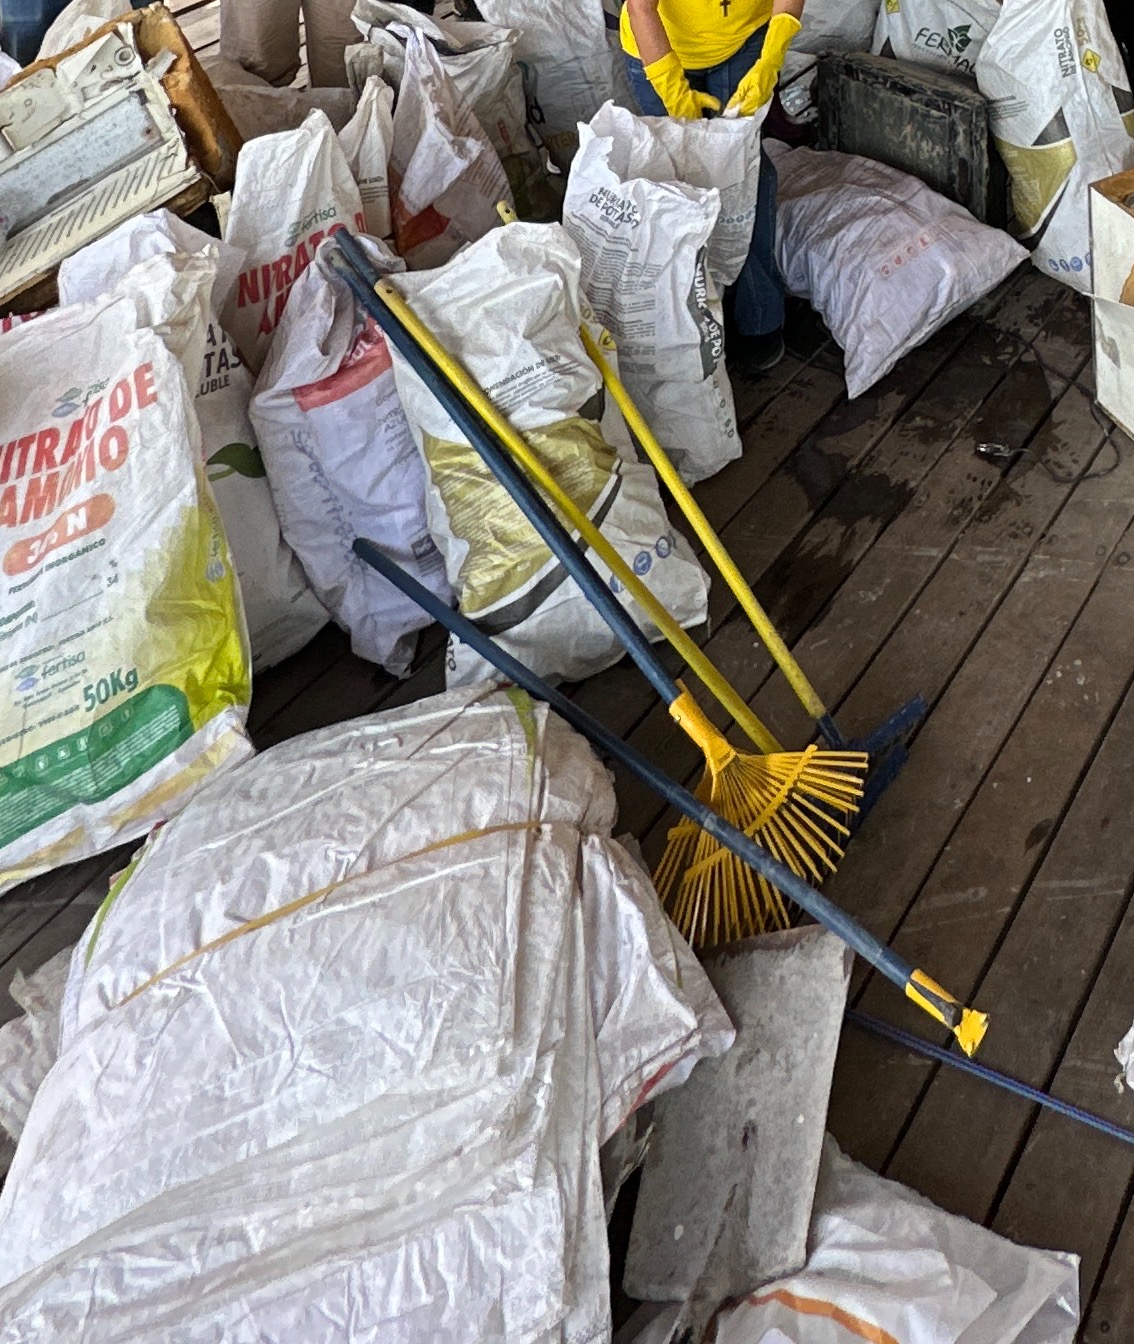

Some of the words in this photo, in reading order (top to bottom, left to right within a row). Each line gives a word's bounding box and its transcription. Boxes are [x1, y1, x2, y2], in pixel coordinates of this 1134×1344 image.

[1054, 28, 1069, 79] NITRATO
[589, 193, 602, 208] DE
[109, 362, 158, 422] DE
[66, 507, 87, 536] N
[41, 650, 86, 680] fertisa
[83, 667, 139, 713] 50Kg
